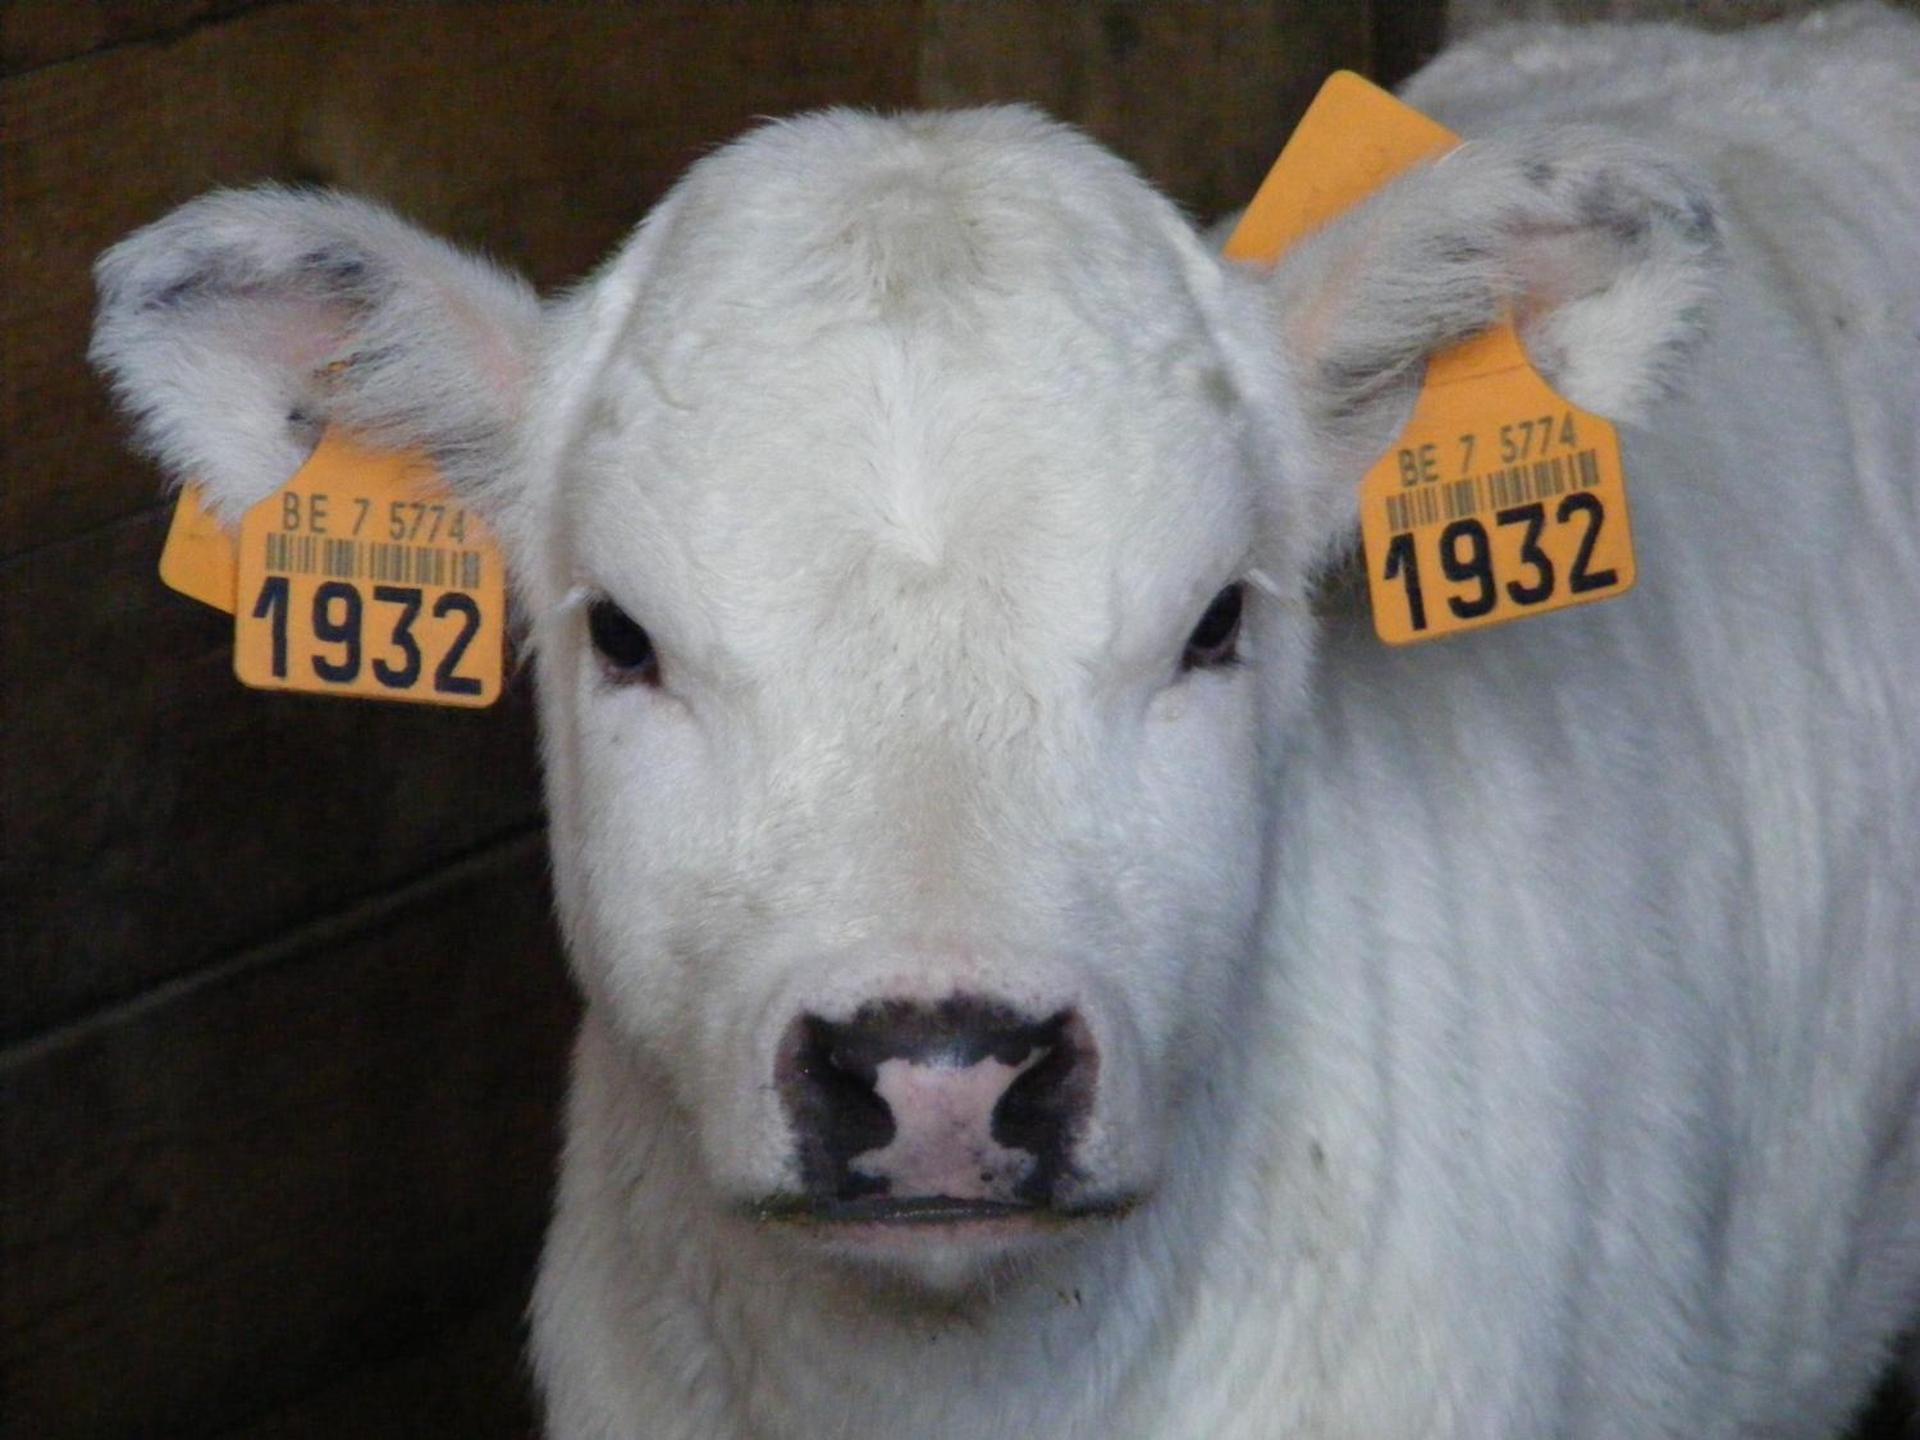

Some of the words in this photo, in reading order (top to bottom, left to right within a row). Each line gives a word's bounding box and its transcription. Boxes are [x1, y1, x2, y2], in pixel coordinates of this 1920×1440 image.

[1398, 444, 1440, 487] BE
[1459, 434, 1476, 474] 7
[1500, 411, 1578, 464] 5774
[283, 491, 329, 534] BE
[352, 497, 370, 536] 7
[390, 501, 466, 545] 5774
[1384, 491, 1619, 631] 1932
[252, 576, 482, 696] 1932
